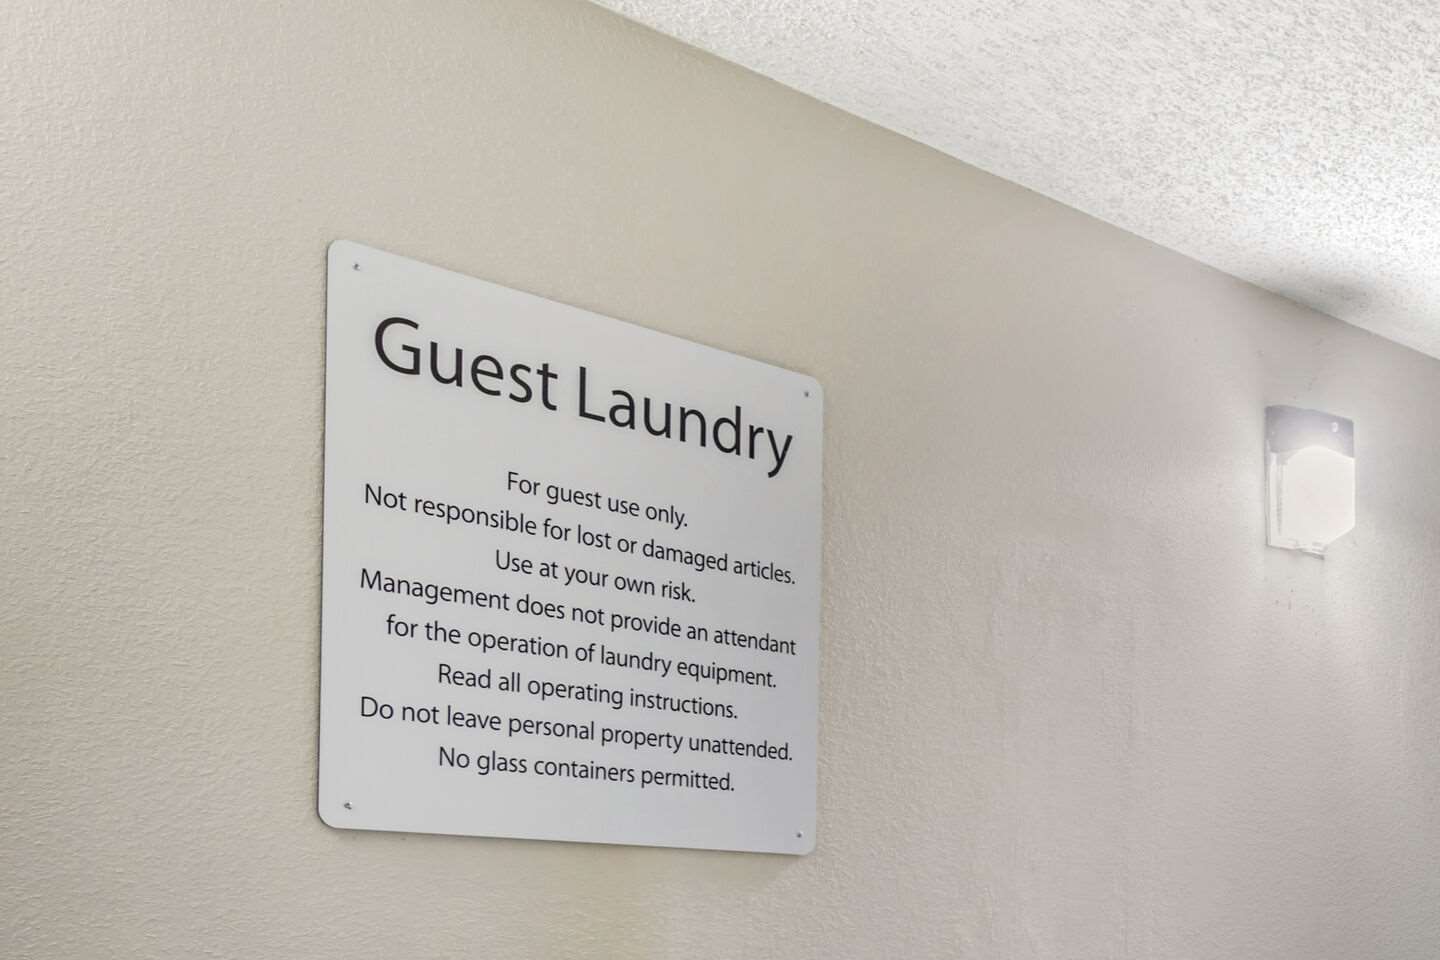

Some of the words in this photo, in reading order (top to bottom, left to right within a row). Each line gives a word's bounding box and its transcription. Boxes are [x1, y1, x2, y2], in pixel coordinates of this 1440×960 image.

[374, 316, 559, 412] Guest
[578, 365, 794, 479] Laundry
[365, 482, 408, 512] Not
[414, 498, 537, 536] responsible
[542, 517, 572, 542] for
[577, 523, 613, 551] lost
[616, 538, 638, 555] or
[642, 538, 729, 573] damaged
[732, 560, 796, 585] articles.
[507, 471, 541, 496] For
[546, 484, 603, 510] guest
[607, 497, 641, 517] use
[644, 504, 688, 531] only.
[495, 548, 533, 575] Use
[538, 561, 559, 580] at
[563, 566, 609, 588] your
[613, 575, 656, 596] own
[661, 580, 696, 603] risk.
[360, 567, 511, 612] Management
[516, 593, 566, 620] does
[571, 607, 605, 627] not
[610, 613, 682, 638] provide
[686, 625, 709, 642] an
[713, 628, 797, 656] attendant
[386, 613, 419, 639] for
[424, 620, 462, 645] the
[467, 631, 569, 660] operation
[574, 642, 597, 663] of
[600, 644, 673, 678] laundry
[676, 661, 777, 689] equipment.
[438, 663, 492, 689] Read
[498, 671, 521, 693] all
[527, 679, 624, 711] operating
[629, 687, 738, 720] instructions.
[360, 695, 394, 720] Do
[402, 706, 440, 725] not
[447, 704, 502, 731] leave
[508, 717, 595, 741] personal
[601, 727, 684, 755] property
[688, 736, 793, 761] unattended.
[439, 746, 471, 769] No
[476, 749, 528, 776] glass
[533, 760, 636, 783] containers
[640, 769, 735, 792] permitted.
